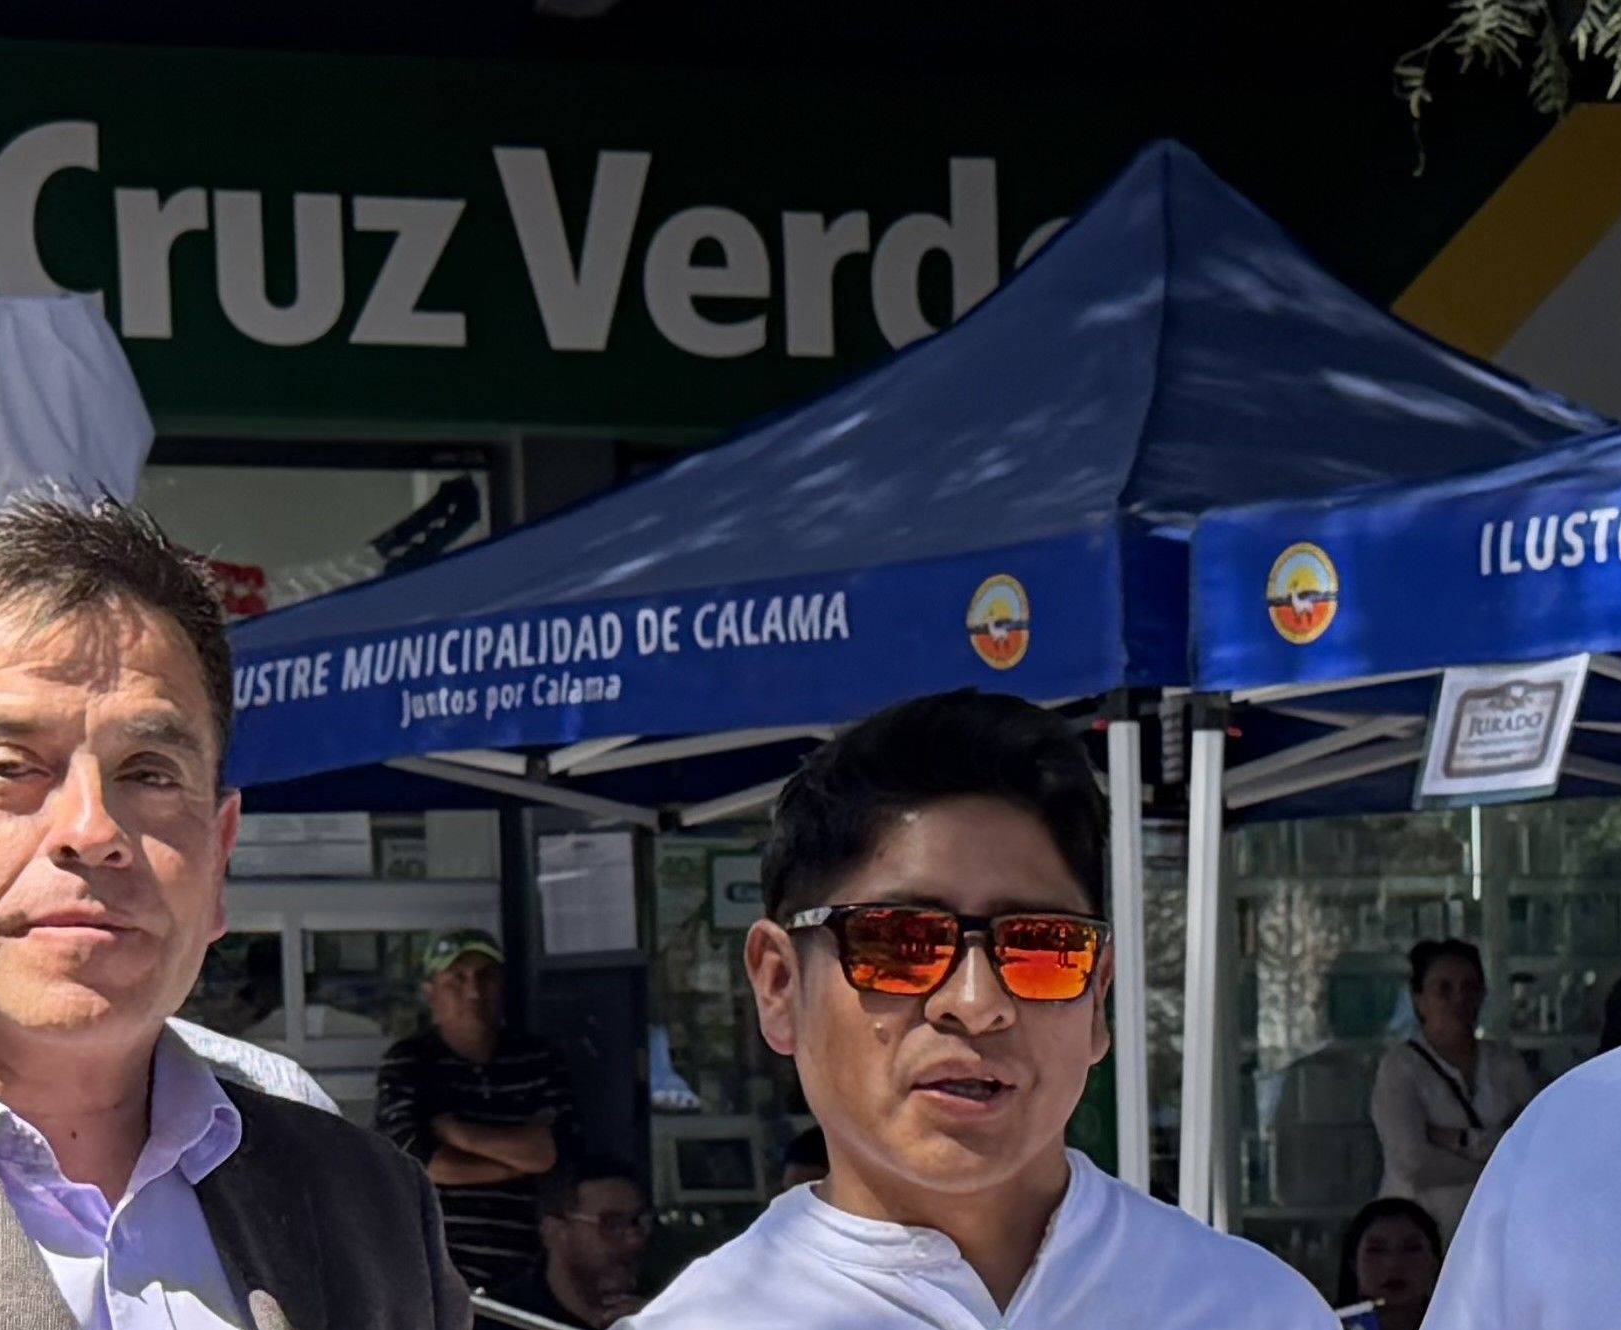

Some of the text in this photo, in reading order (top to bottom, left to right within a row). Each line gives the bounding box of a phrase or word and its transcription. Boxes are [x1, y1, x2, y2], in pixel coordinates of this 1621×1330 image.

[492, 146, 1072, 358] Verd
[233, 592, 851, 710] USTRE MUNICIPALIDAD DE CALAMA
[400, 672, 622, 729] Juntos por Calama
[1469, 712, 1543, 737] JURADO
